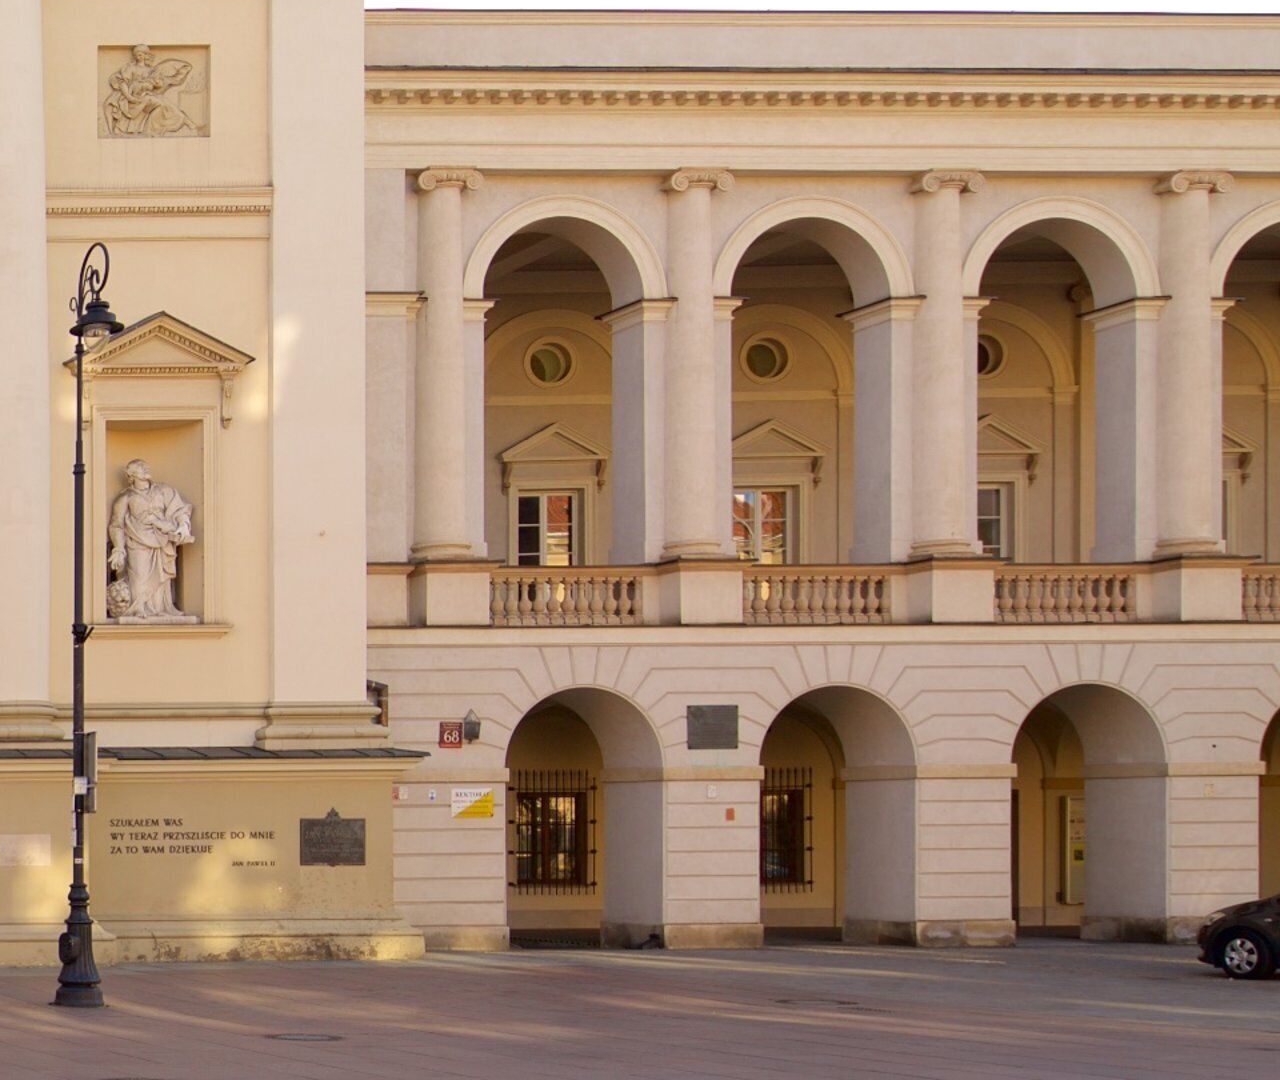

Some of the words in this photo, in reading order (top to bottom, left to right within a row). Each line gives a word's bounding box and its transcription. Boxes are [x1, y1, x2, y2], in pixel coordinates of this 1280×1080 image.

[444, 730, 460, 743] 68
[163, 819, 183, 827] WAS
[110, 832, 125, 841] WY
[129, 832, 159, 841] TERAZ
[230, 831, 245, 839] DO
[249, 831, 275, 840] MNIE
[110, 846, 122, 855] ZA
[126, 846, 138, 854] TO
[142, 846, 165, 854] WAM
